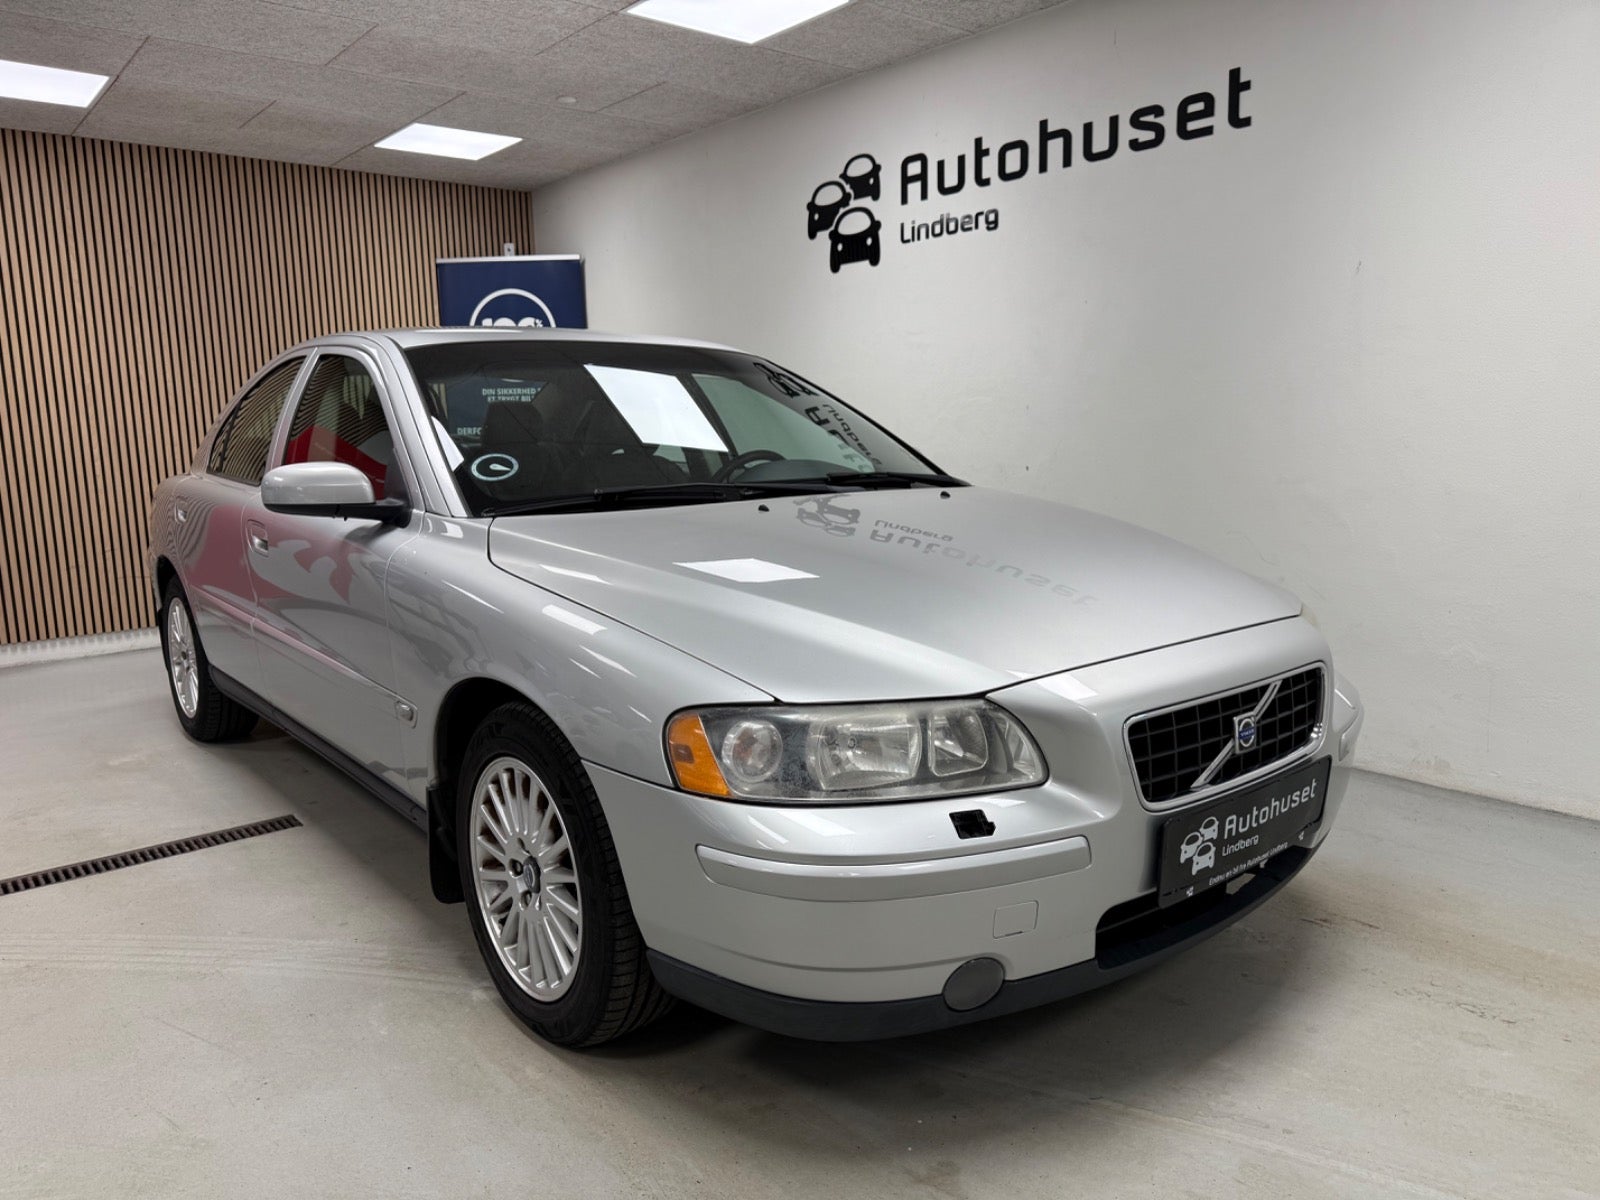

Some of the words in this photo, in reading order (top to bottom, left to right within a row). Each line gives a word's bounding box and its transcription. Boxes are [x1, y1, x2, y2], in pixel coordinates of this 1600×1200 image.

[900, 66, 1252, 206] Autohuset
[900, 208, 999, 244] Lindberg
[482, 387, 495, 396] DIN
[1223, 778, 1318, 840] Autohuset
[1221, 834, 1260, 857] Lindberg
